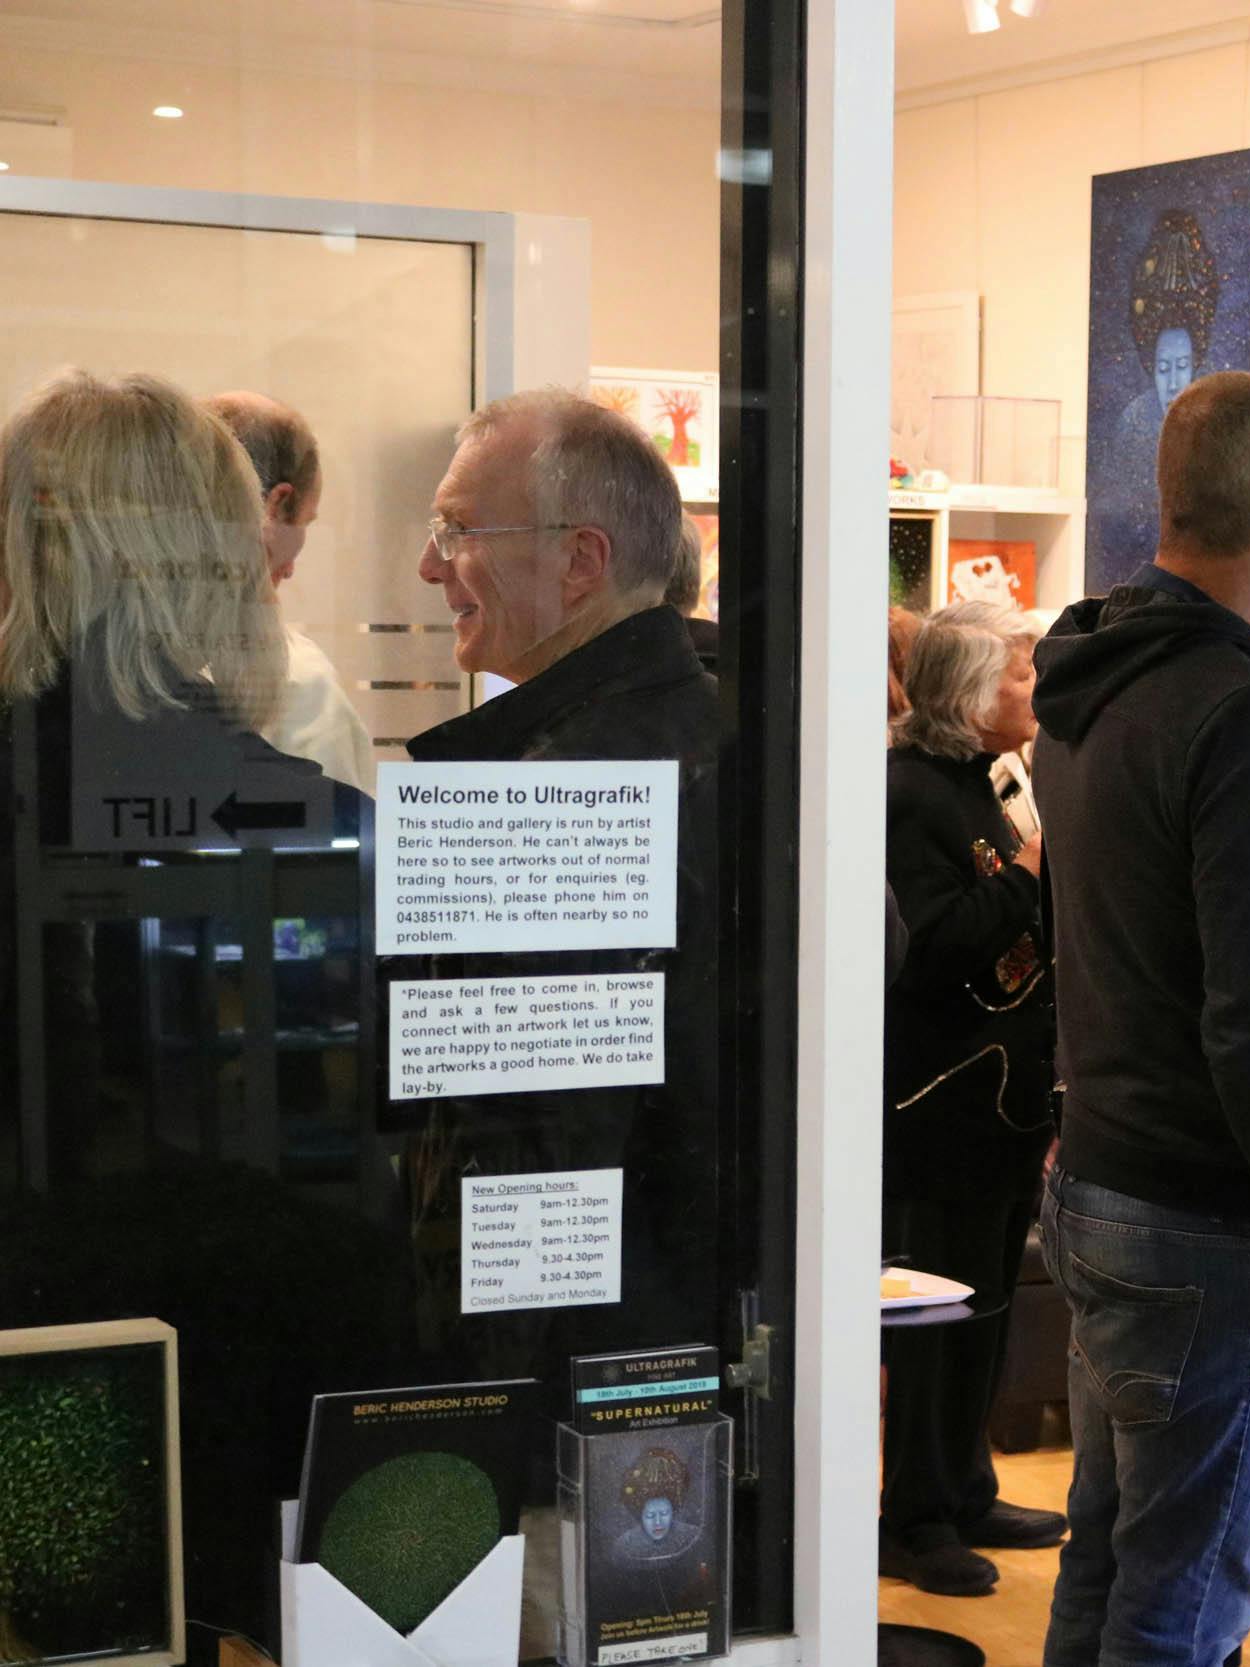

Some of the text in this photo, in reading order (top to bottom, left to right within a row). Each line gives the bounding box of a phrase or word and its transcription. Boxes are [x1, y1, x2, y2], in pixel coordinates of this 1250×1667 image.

[399, 786, 650, 808] Welcome to Ultragrafik!
[399, 817, 650, 832] This studio and gallery is run by artist
[398, 836, 650, 850] Beric Henderson. He can't always be
[398, 854, 650, 867] here so to see artworks out of normal
[398, 872, 648, 887] trading hours, or for enquiries (eg.
[504, 891, 547, 904] please
[554, 891, 595, 904] phone
[603, 890, 626, 901] him
[633, 892, 648, 901] on
[486, 911, 502, 922] He
[508, 910, 518, 921] is
[524, 910, 558, 921] often
[563, 910, 607, 922] nearby
[613, 912, 628, 920] so
[633, 911, 648, 919] no
[397, 931, 456, 944] problem.
[460, 986, 484, 997] feel
[490, 985, 515, 996] free
[522, 985, 535, 995] to
[542, 983, 577, 994] come
[607, 979, 653, 991] browse
[402, 998, 653, 1019] and ask a few questions. If you
[402, 1026, 456, 1038] connect
[462, 1023, 490, 1035] with
[496, 1023, 511, 1033] an
[518, 1019, 567, 1032] artwork
[573, 1018, 589, 1029] let
[595, 1018, 609, 1028] us
[402, 1033, 653, 1057] we are happy to negotiate in order find
[402, 1050, 653, 1075] the artworks a good home. We do take
[402, 1082, 446, 1095] lay-by.
[472, 1182, 578, 1194] New Opening hours:
[472, 1197, 608, 1214] Saturday 9am-12.30pm
[472, 1216, 608, 1232] Tuesday 9am-12.30pm
[472, 1234, 609, 1250] Wednesday 9am-12.30pm
[472, 1258, 520, 1269] Thursday
[472, 1278, 503, 1288] Friday
[471, 1288, 607, 1307] Closed Sunday and Monday
[626, 1358, 696, 1372] ULTRAGRAFIK
[353, 1395, 508, 1415] BERIC HENDERSON STUDIO
[601, 1650, 640, 1664] PLEASE
[648, 1646, 674, 1657] TAKE
